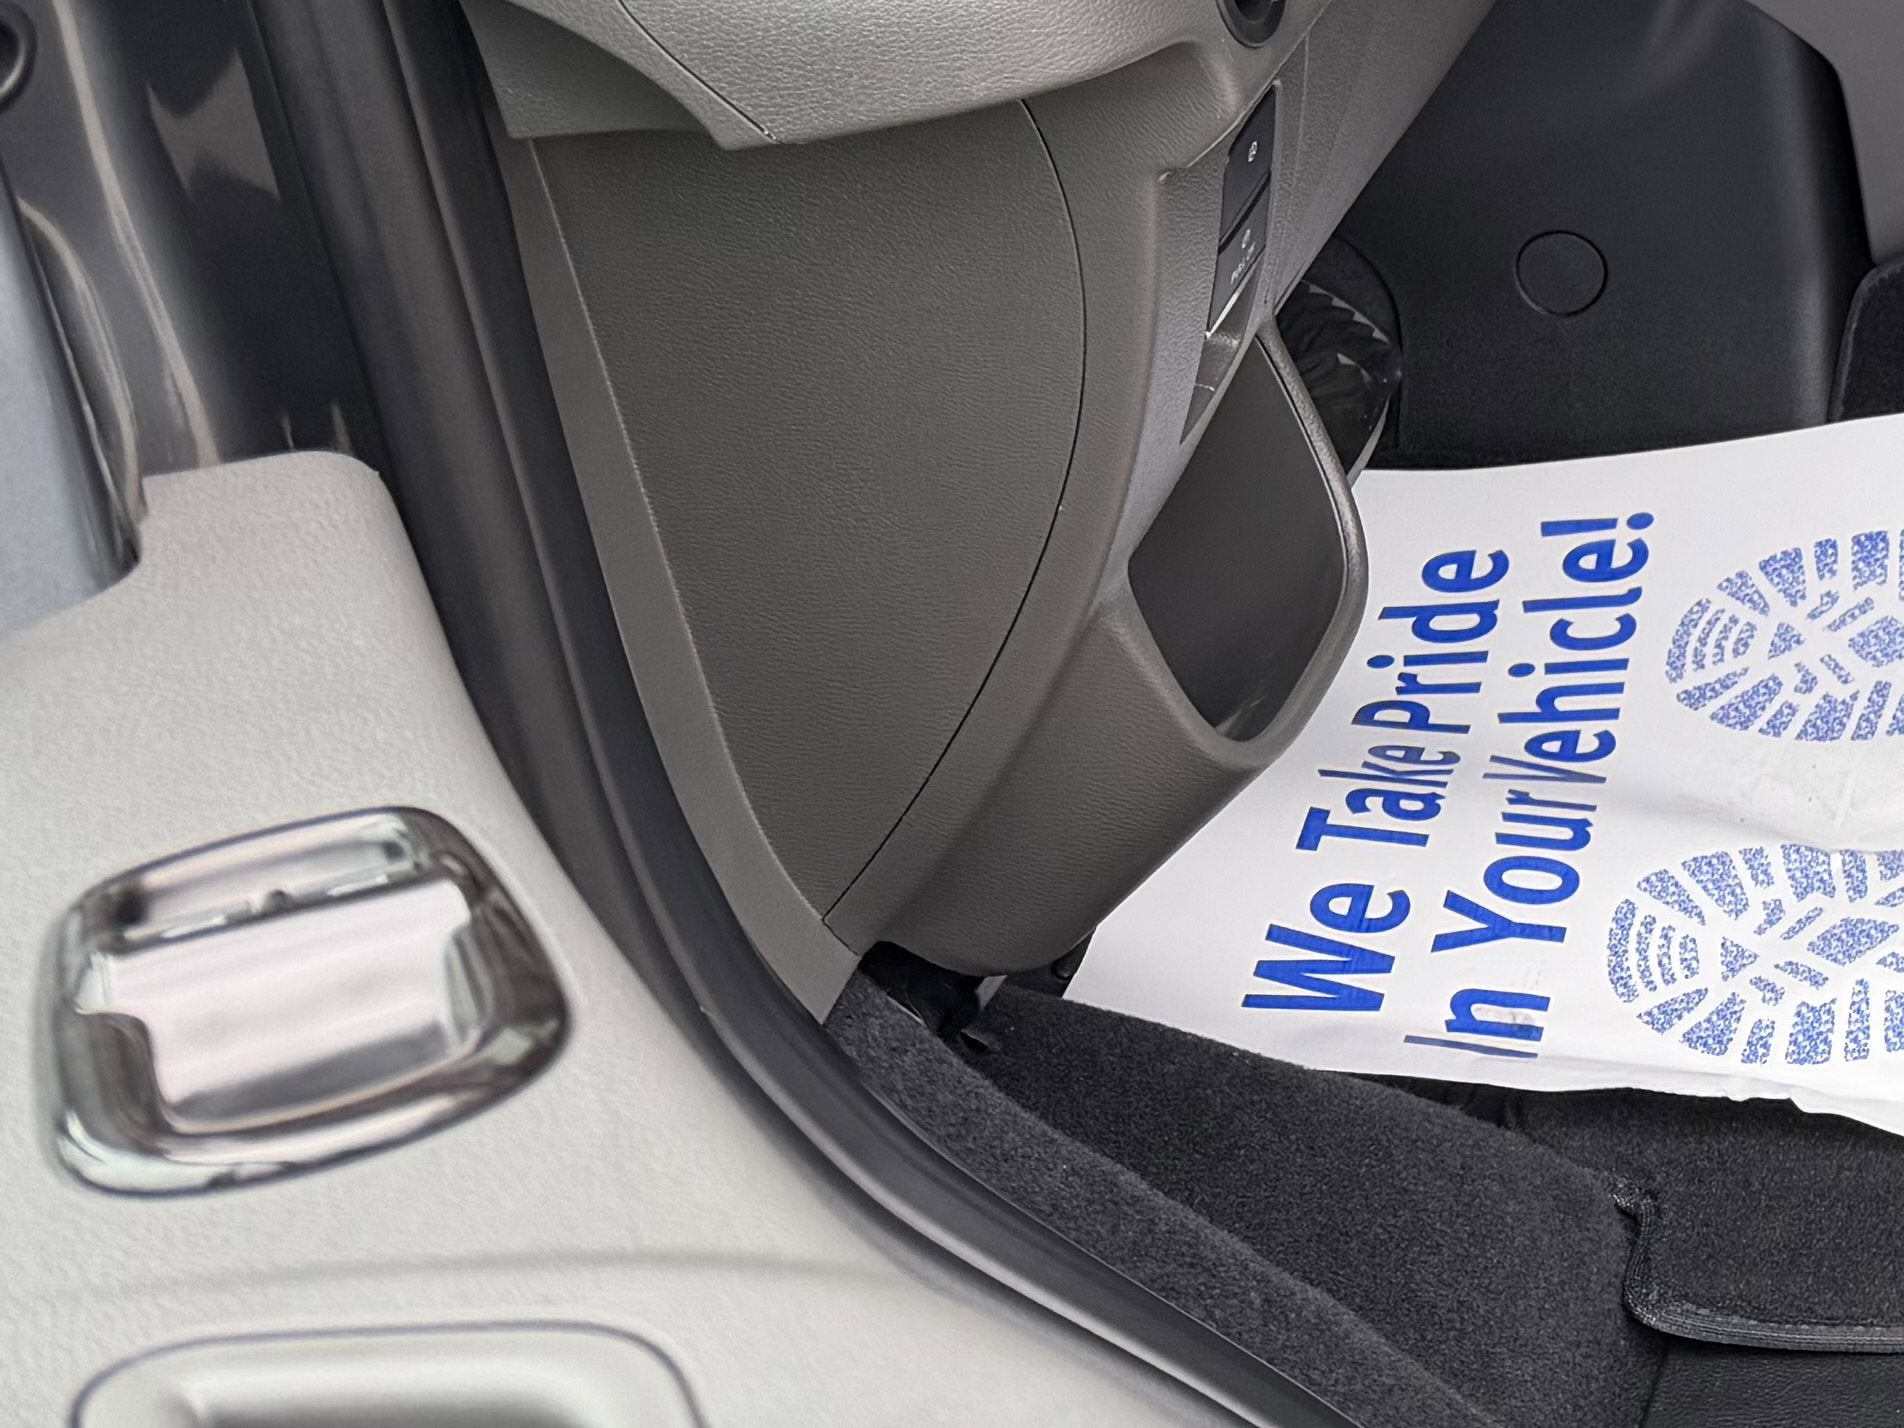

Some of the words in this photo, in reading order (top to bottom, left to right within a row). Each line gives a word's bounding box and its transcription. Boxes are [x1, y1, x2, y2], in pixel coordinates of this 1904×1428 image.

[1351, 549, 1510, 734] Pride
[1483, 511, 1655, 784] Vehicle!
[1296, 744, 1461, 851] Take
[1431, 789, 1598, 953] Your
[1241, 882, 1411, 1012] We
[1403, 986, 1551, 1058] In
